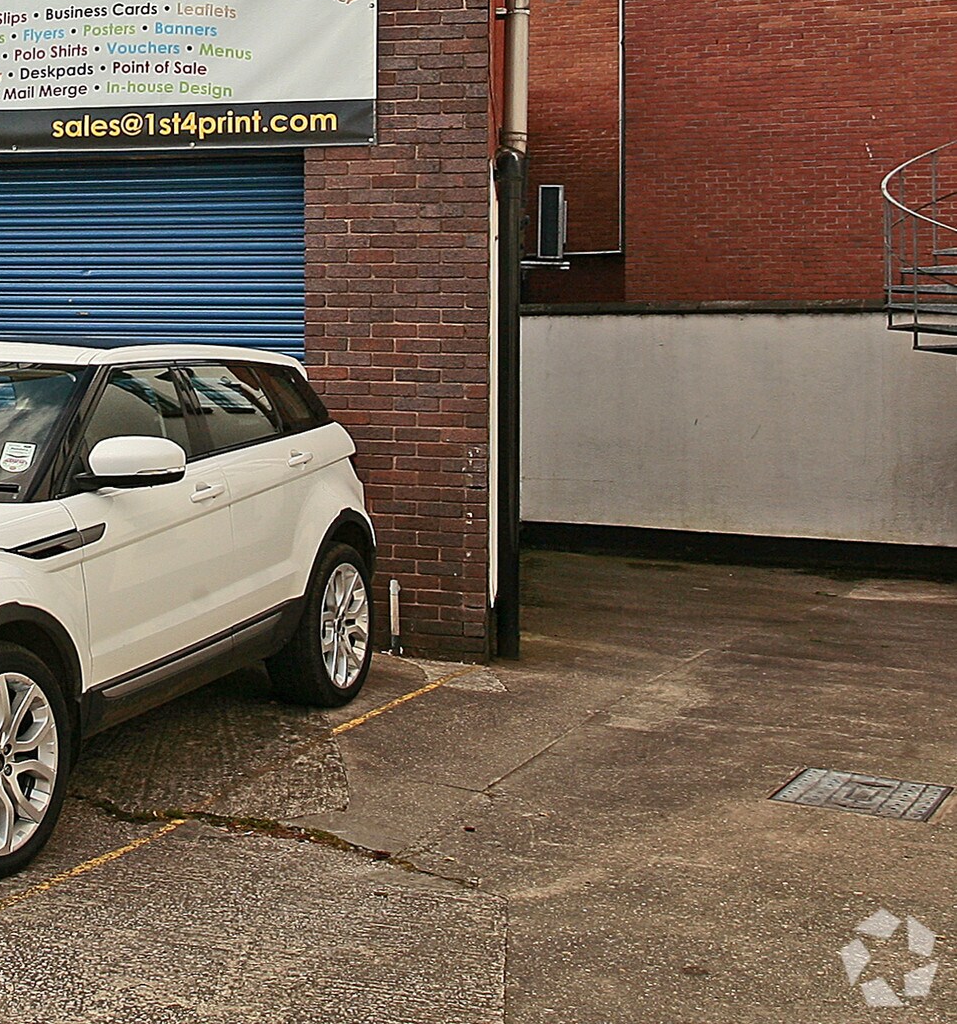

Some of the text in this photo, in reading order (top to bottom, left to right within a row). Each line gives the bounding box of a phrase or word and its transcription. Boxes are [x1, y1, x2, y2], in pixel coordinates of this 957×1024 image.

[45, 4, 108, 21] Business
[112, 2, 158, 16] Cards
[176, 2, 237, 19] Leaflets
[23, 27, 65, 43] Flyers
[82, 23, 136, 37] Posters
[154, 22, 218, 37] Banners
[14, 48, 45, 62] Polo
[50, 43, 88, 58] Shirts
[106, 41, 180, 55] Vouchers
[199, 43, 252, 60] Menus
[20, 63, 94, 80] Deskpads
[112, 60, 150, 74] Point
[154, 60, 169, 74] of
[174, 62, 207, 75] Sale
[3, 85, 35, 101] Mail
[38, 83, 88, 99] Merge
[106, 81, 174, 94] In-house
[179, 81, 232, 99] Design
[52, 110, 337, 140] sales@1st4print.com
